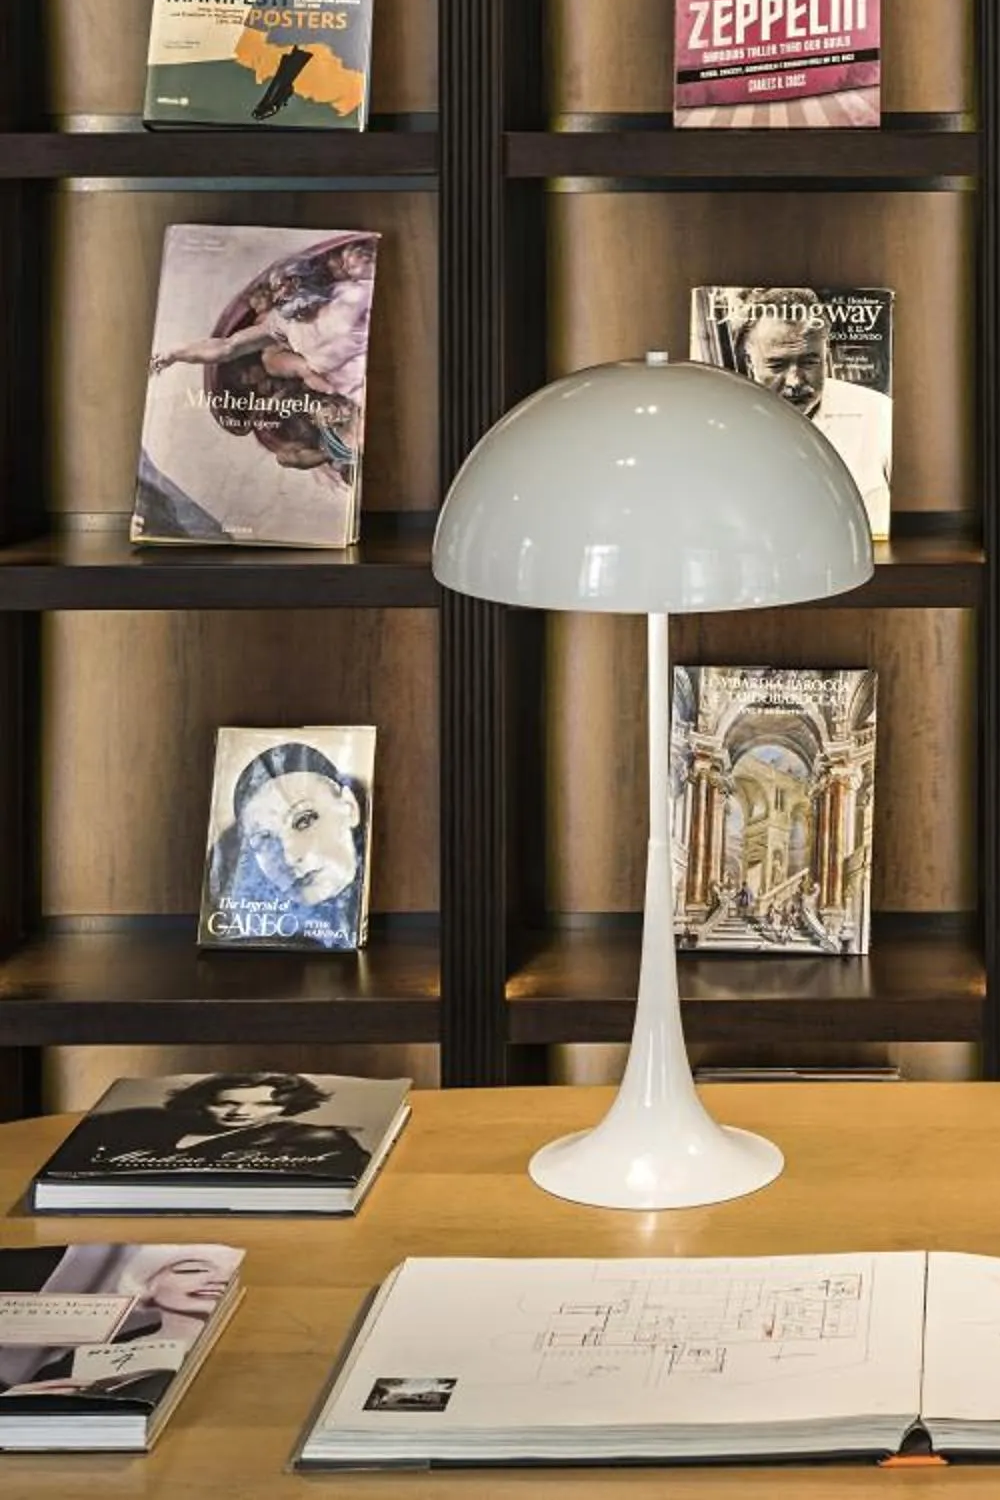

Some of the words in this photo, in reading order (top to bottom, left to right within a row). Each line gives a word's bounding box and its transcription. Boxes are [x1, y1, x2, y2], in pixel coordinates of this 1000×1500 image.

[250, 9, 348, 29] POSTERS
[707, 293, 883, 331] Hemingway
[184, 389, 322, 418] Michelangelo
[207, 912, 299, 937] GARBO
